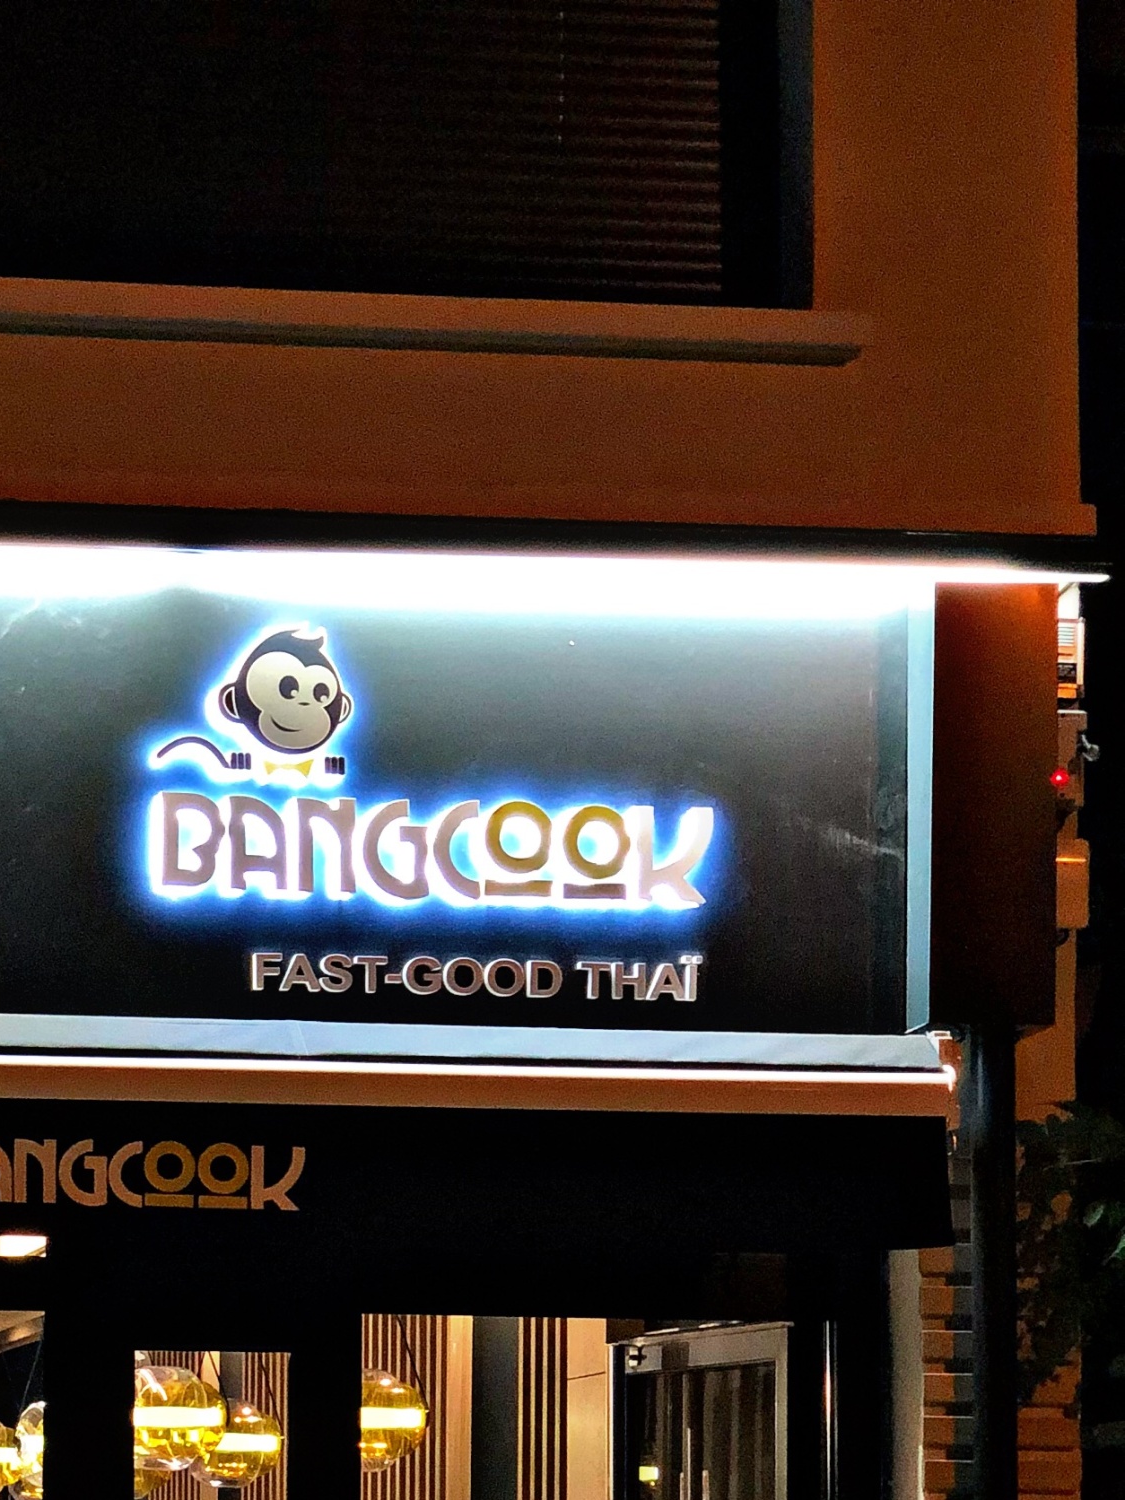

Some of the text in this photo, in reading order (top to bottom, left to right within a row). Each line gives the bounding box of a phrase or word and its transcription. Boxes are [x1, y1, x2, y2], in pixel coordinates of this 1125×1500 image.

[159, 791, 715, 906] BANGCOOK
[250, 951, 703, 1002] FAST-GOOD THAÏ
